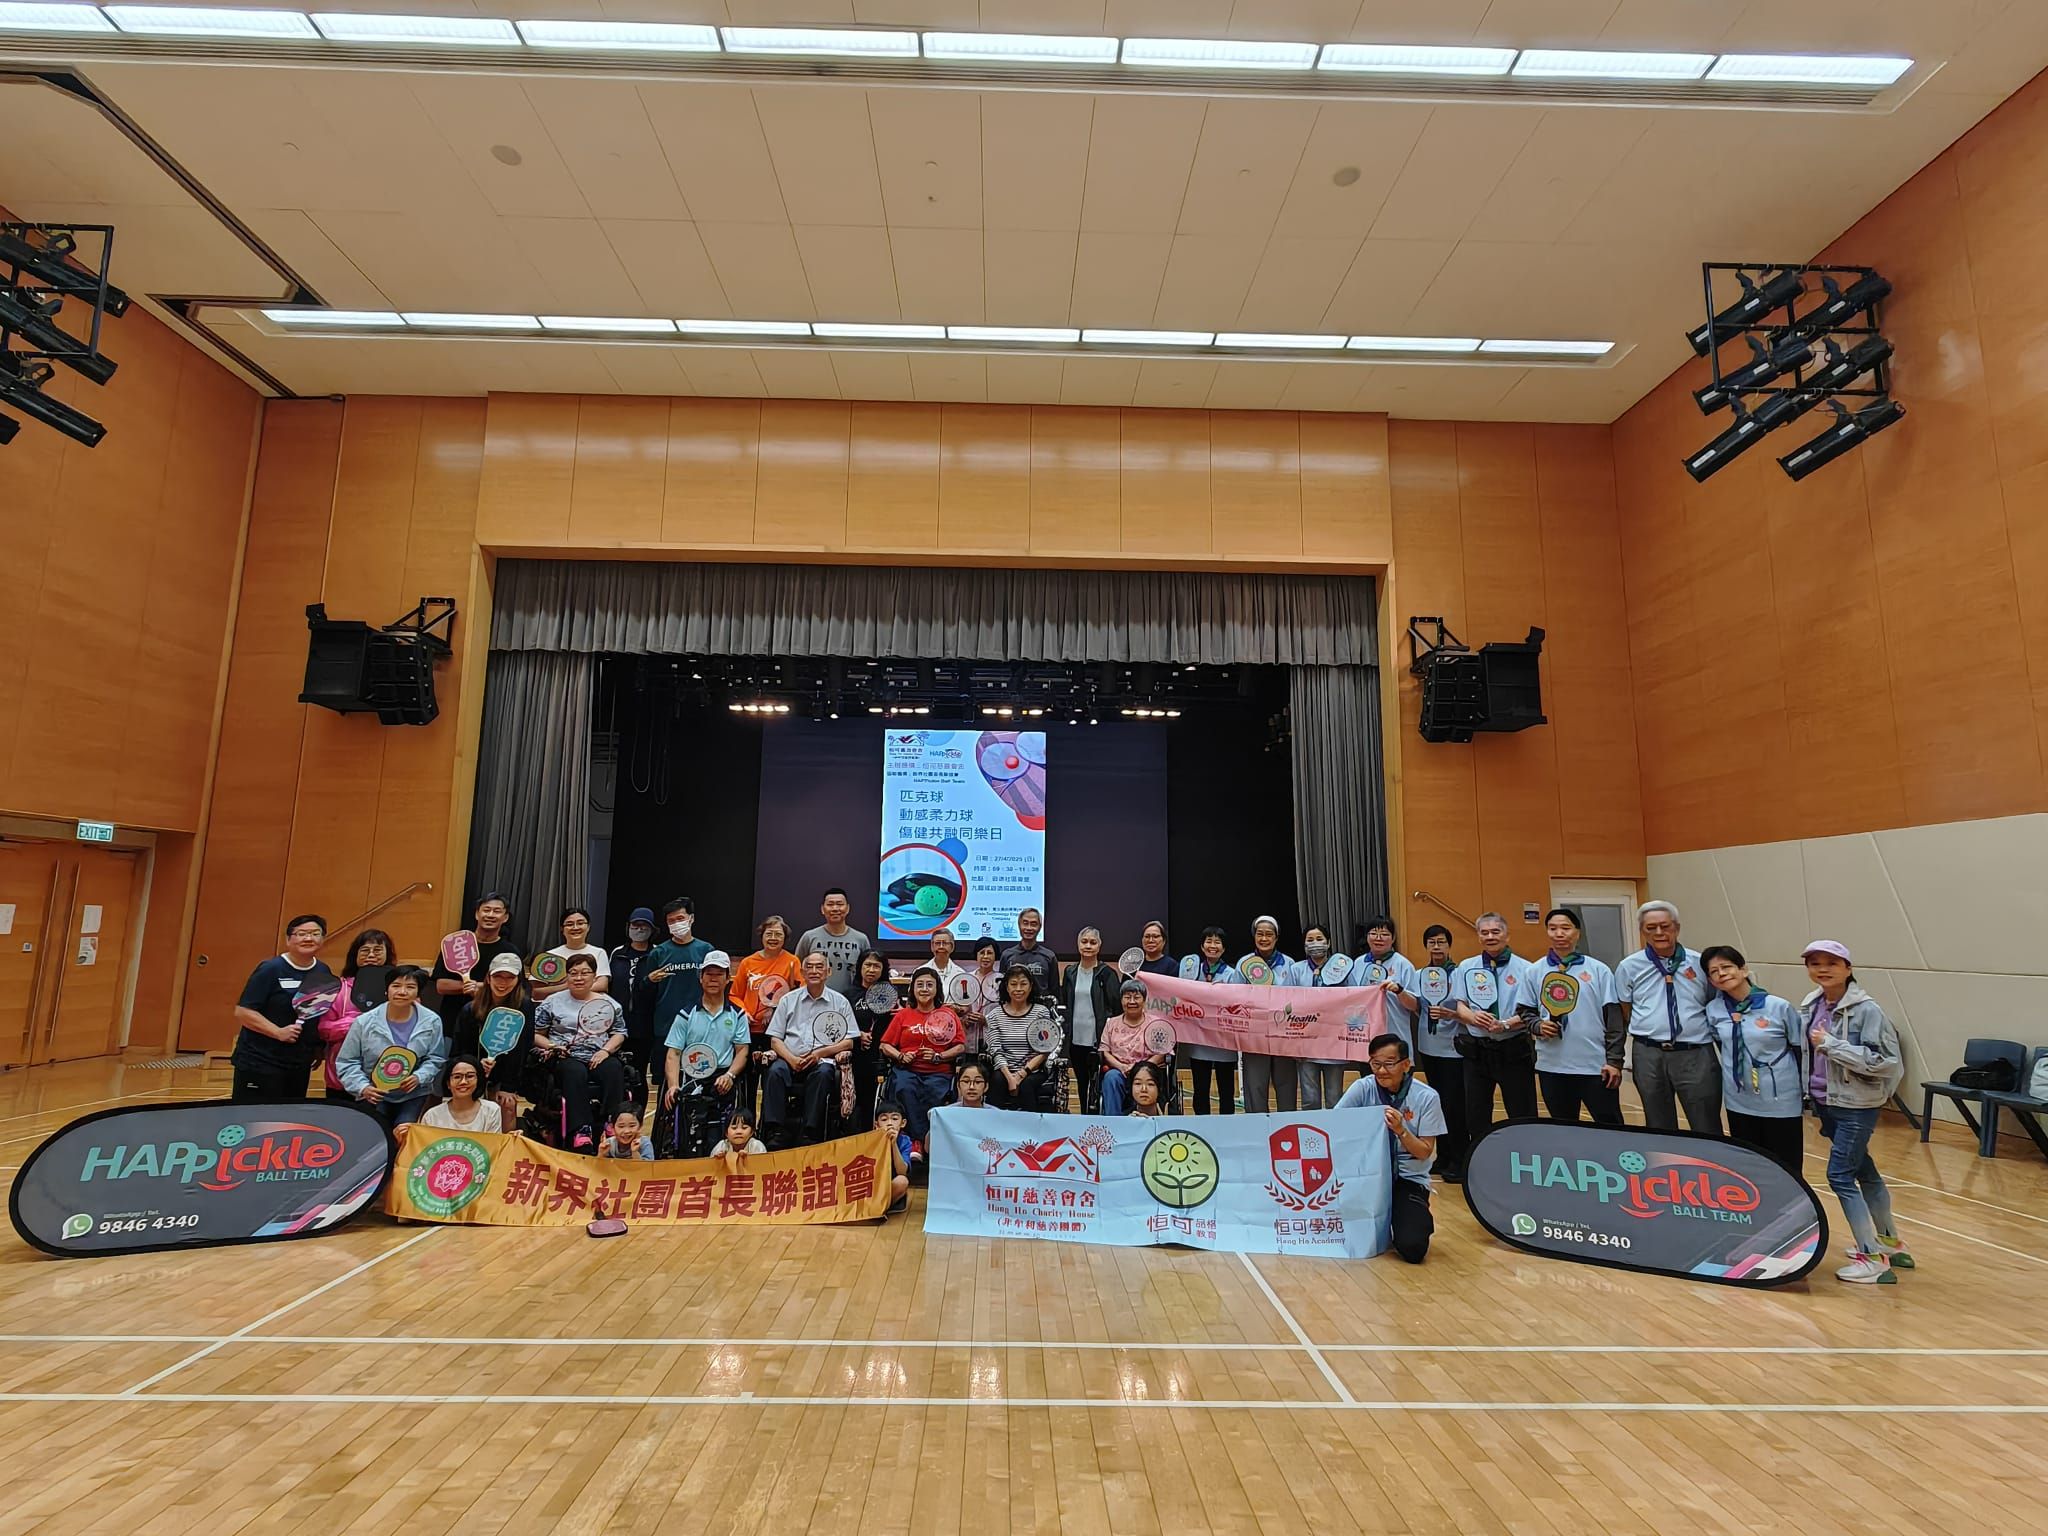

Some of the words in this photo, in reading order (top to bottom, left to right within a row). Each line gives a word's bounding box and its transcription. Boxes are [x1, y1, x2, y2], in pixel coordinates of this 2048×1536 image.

[900, 790, 944, 803] 匹克球
[899, 808, 973, 822] 動感柔力球
[899, 826, 1002, 840] 傷健共融同樂日
[1287, 1014, 1318, 1023] Health
[256, 1170, 288, 1183] BALL
[293, 1167, 330, 1181] TEAM
[502, 1154, 877, 1221] 新界社團首長聯誼會
[986, 1184, 1095, 1208] 恒可慈善會舍
[988, 1203, 1009, 1215] Hang
[1014, 1206, 1028, 1215] Ho
[1032, 1208, 1063, 1218] Charity
[1069, 1210, 1095, 1218] House
[1673, 1204, 1709, 1220] BALL
[1712, 1210, 1753, 1225] TEAM
[97, 1219, 148, 1234] 9846
[152, 1214, 199, 1230] 4340
[1196, 1219, 1216, 1229] 品格
[1274, 1217, 1344, 1235] 恒可學苑
[1542, 1218, 1575, 1228] WhatsApp
[1276, 1237, 1296, 1245] Hang
[1312, 1237, 1345, 1245] Academy
[1542, 1226, 1584, 1242] 9846
[1588, 1232, 1631, 1249] 4340
